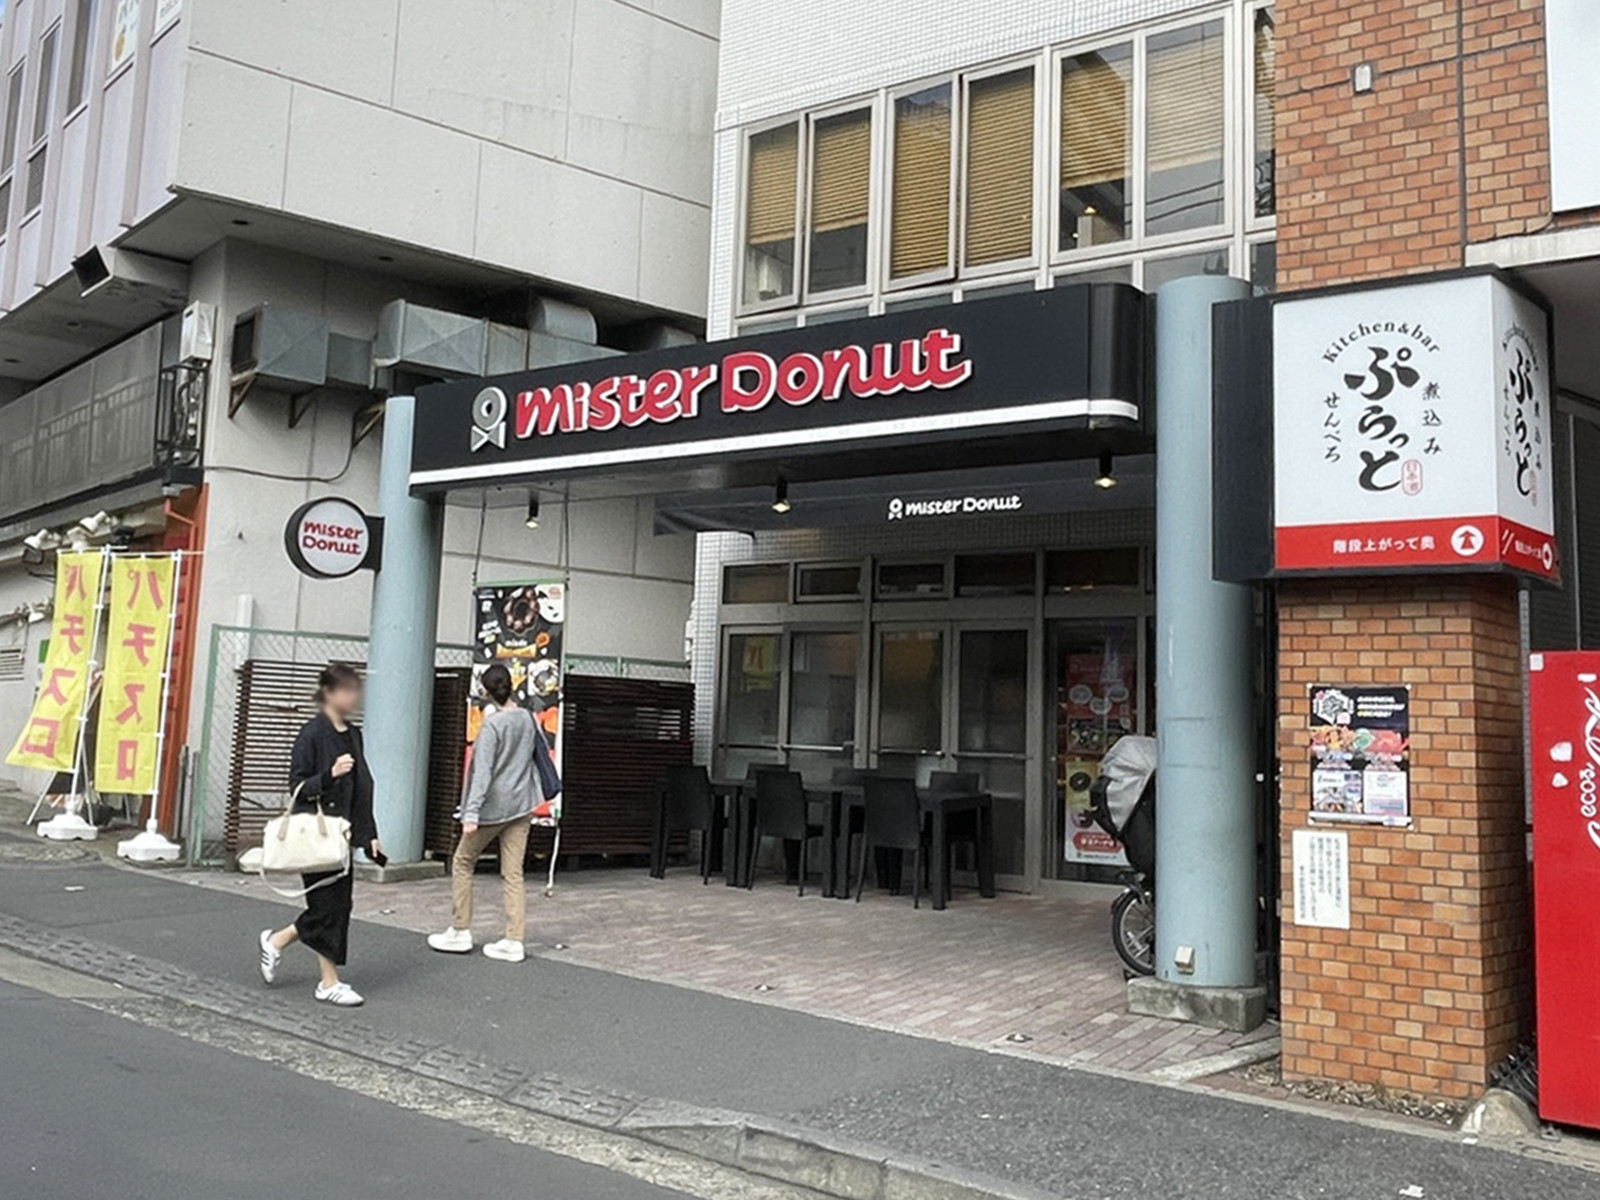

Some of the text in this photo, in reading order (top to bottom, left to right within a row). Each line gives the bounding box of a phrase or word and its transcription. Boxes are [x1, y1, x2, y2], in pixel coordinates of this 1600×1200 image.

[1322, 322, 1440, 363] Kitchen&bar
[515, 328, 973, 440] mister Donut
[1323, 392, 1342, 463] せんべろ
[1344, 346, 1421, 492] ぷらっと
[905, 495, 1022, 516] mister Donut
[302, 535, 362, 555] Donut
[303, 521, 364, 540] mister
